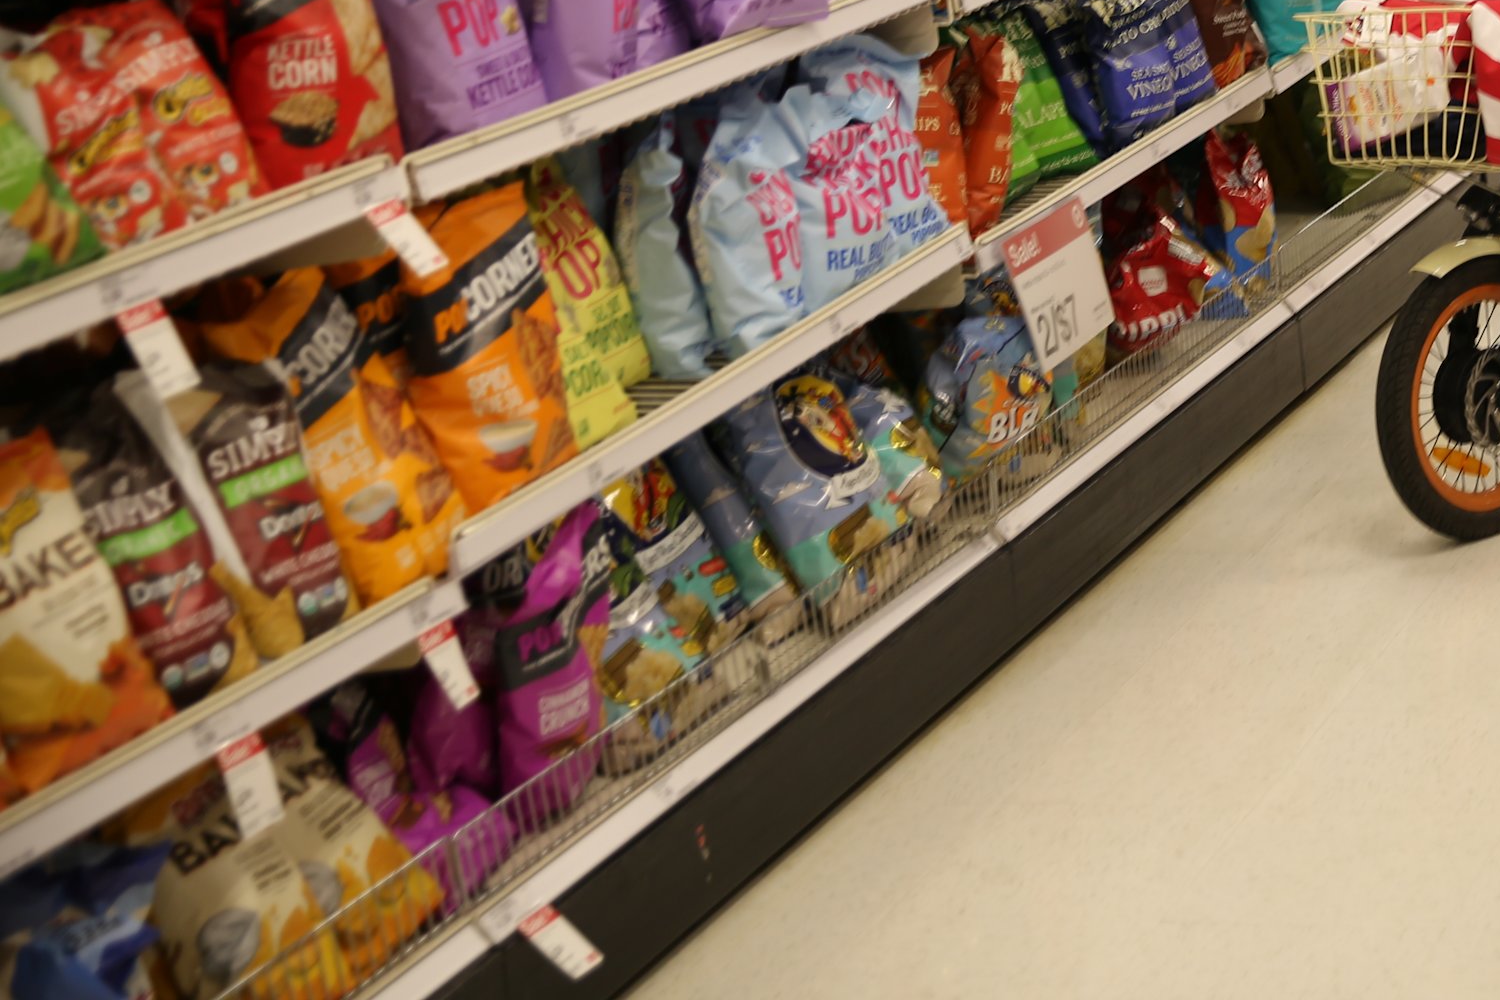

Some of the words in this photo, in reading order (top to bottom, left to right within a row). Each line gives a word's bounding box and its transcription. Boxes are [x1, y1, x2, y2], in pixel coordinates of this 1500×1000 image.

[268, 33, 335, 63] KETTLE
[269, 55, 338, 91] CORN
[826, 246, 864, 272] REAL
[1008, 231, 1043, 269] Sale!
